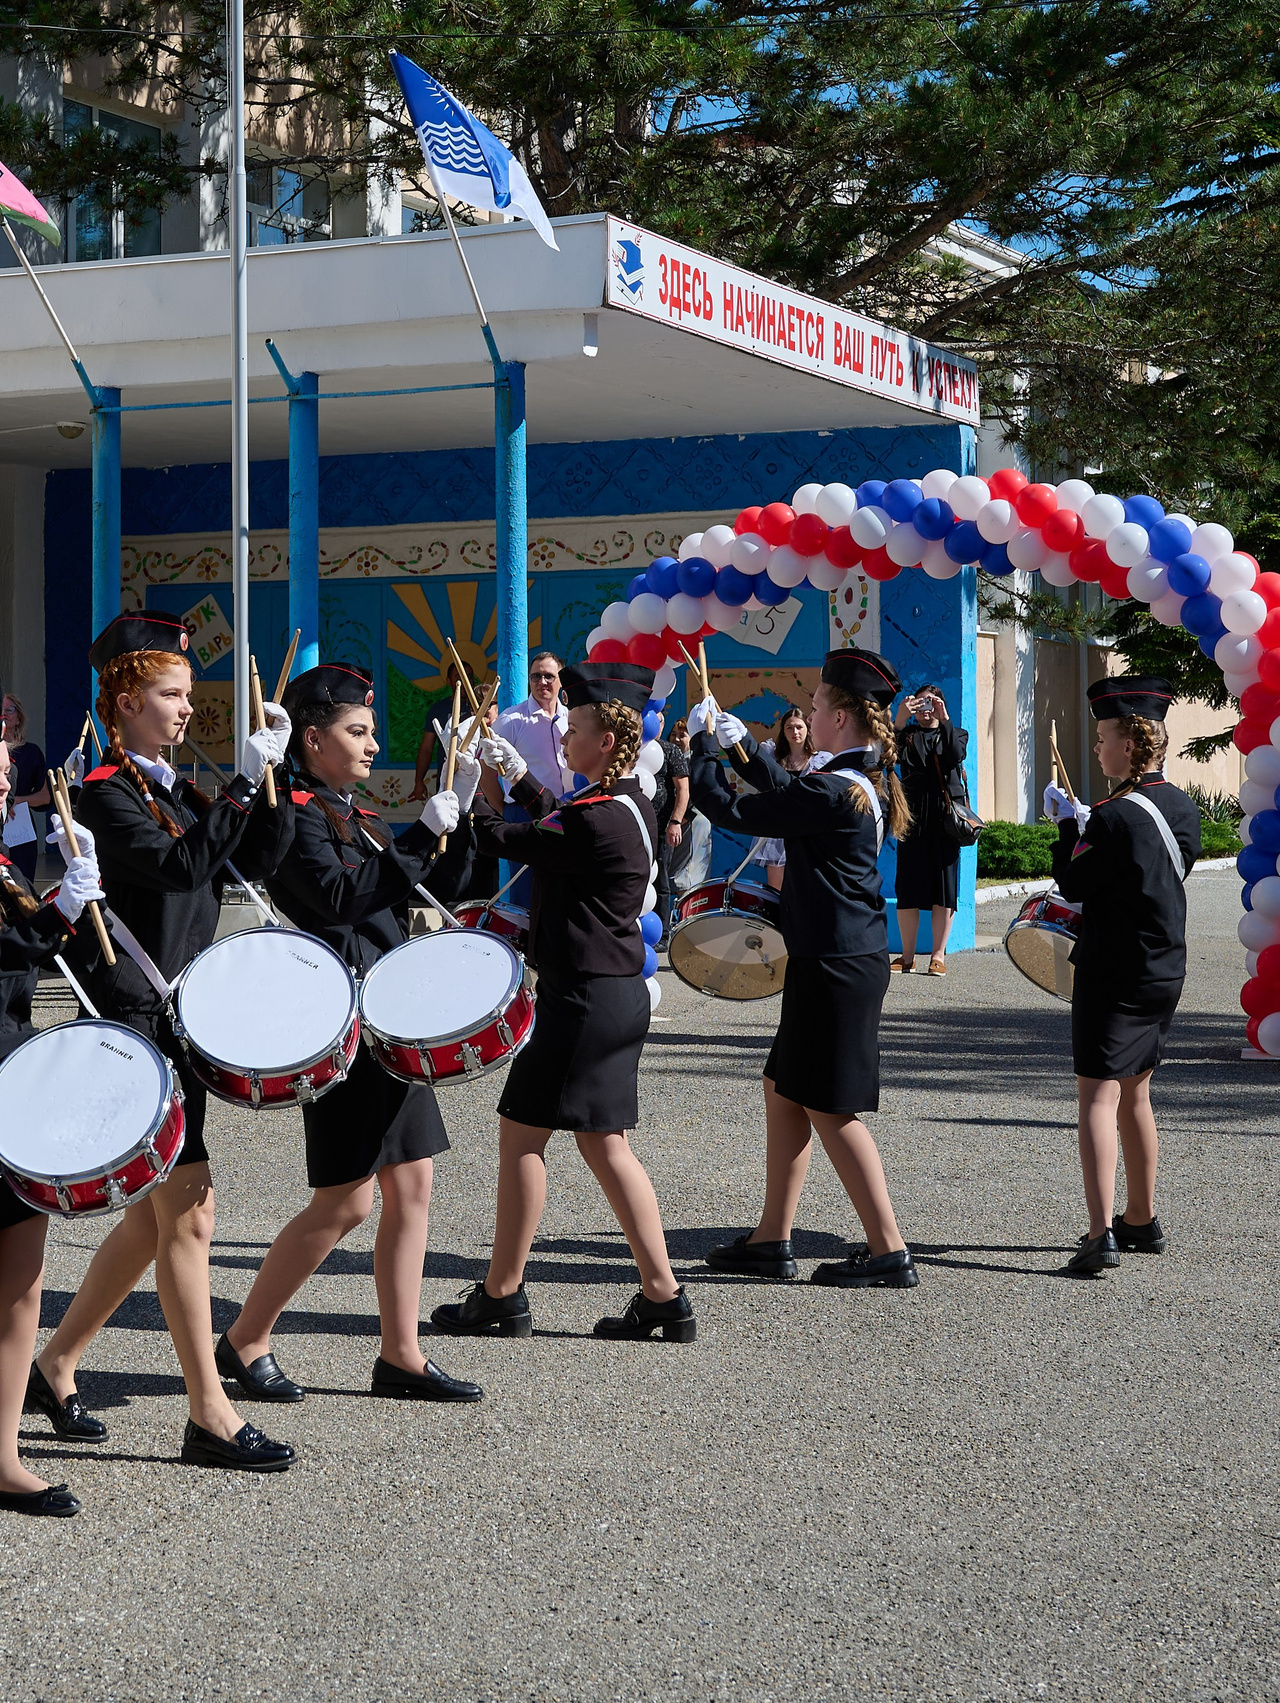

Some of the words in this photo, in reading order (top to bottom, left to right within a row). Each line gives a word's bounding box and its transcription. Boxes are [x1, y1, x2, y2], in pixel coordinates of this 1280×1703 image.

[658, 253, 714, 321] ЗДЕСЬ
[723, 281, 824, 361] НАЧИНАЕТСЯ
[834, 321, 864, 374] ВАШ
[870, 335, 904, 387] ПУТЬ
[912, 350, 920, 394] К
[927, 356, 977, 412] УСПЕХУ!
[198, 632, 232, 664] ВАРЬ
[99, 1040, 133, 1061] BRAHNER
